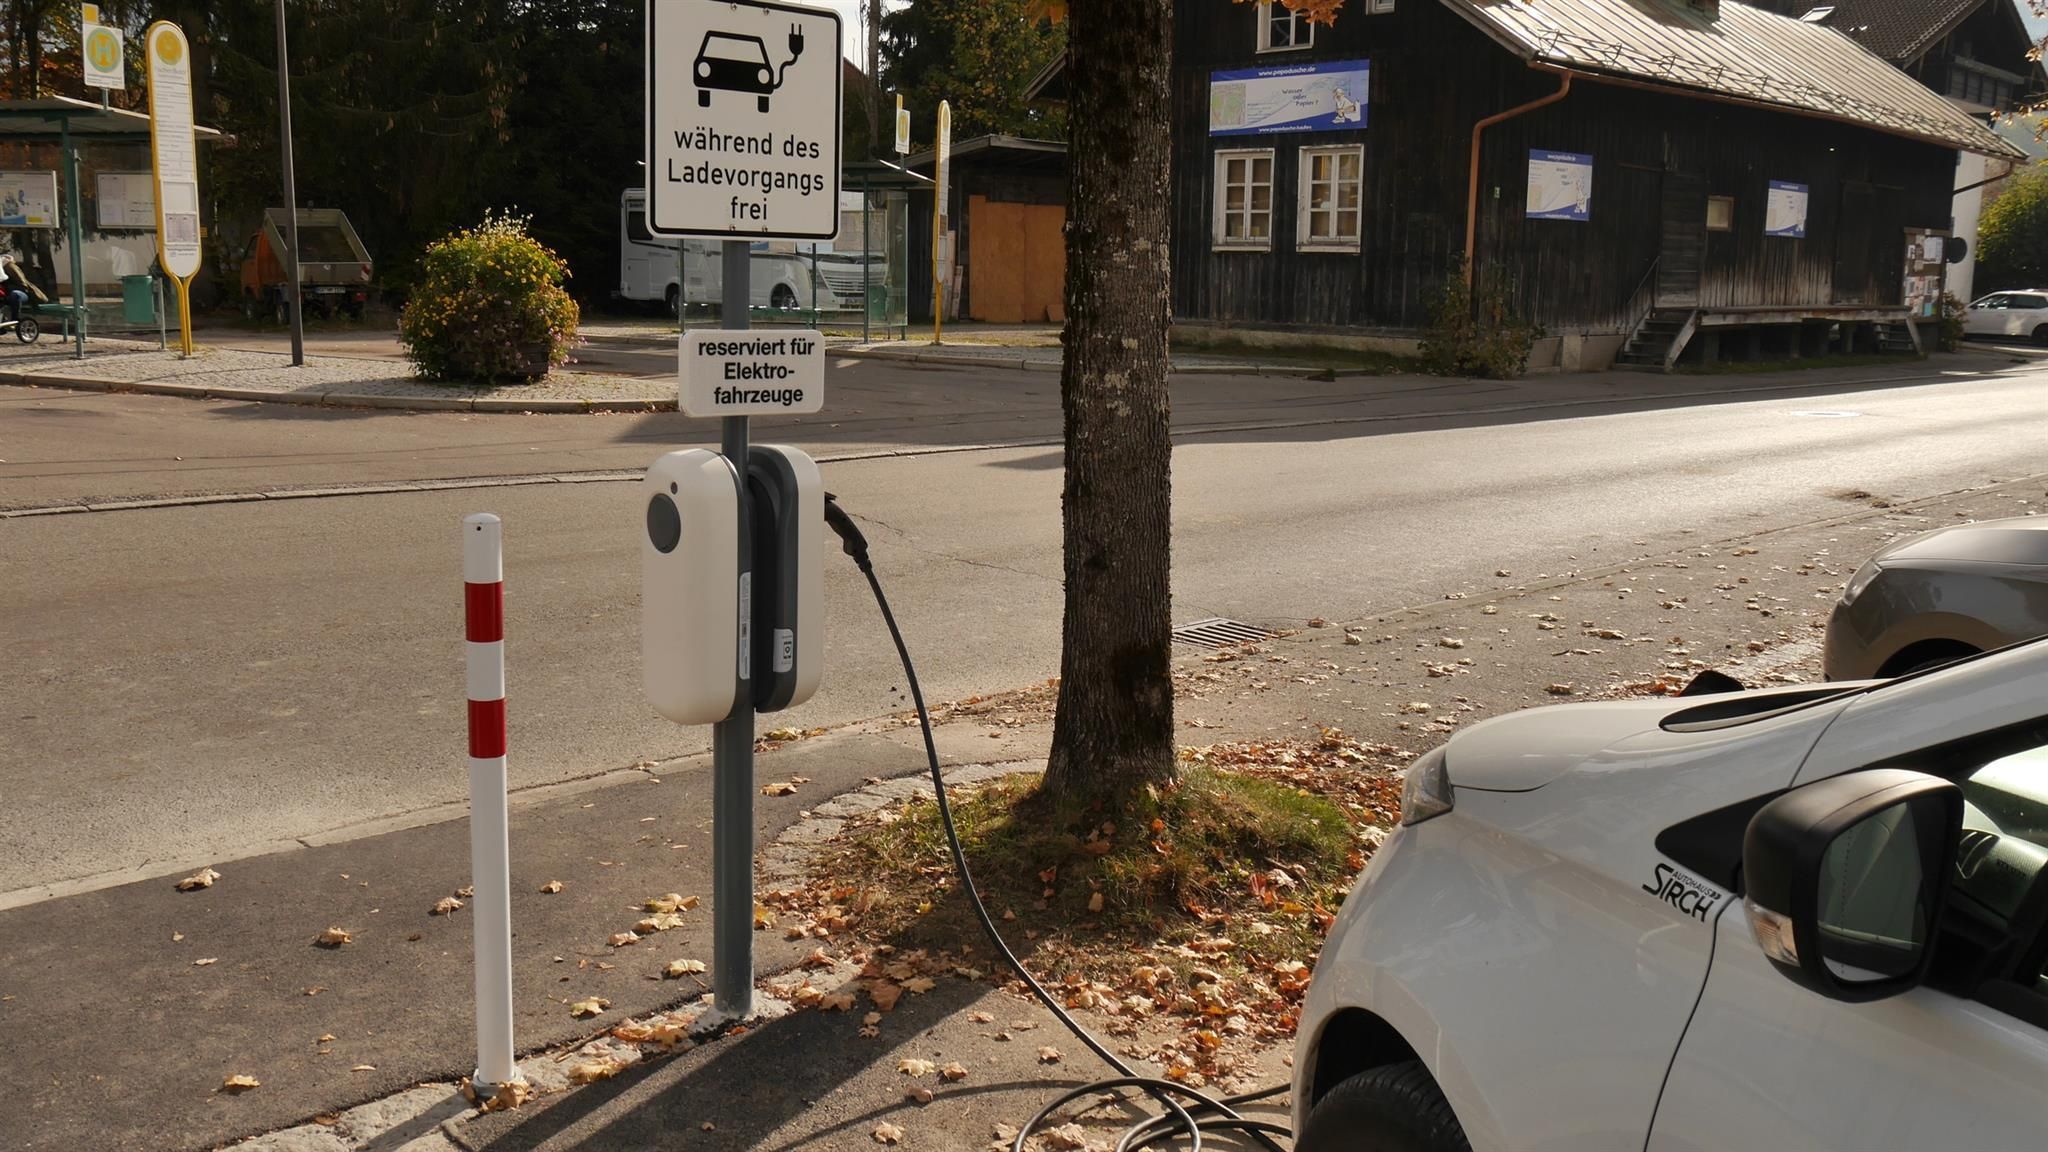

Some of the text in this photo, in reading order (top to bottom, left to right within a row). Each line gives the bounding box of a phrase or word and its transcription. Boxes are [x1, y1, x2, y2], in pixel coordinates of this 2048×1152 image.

[96, 38, 112, 63] H
[674, 126, 820, 159] während des
[668, 158, 824, 196] Ladevorgangs
[730, 196, 768, 220] frei
[698, 338, 815, 356] reserviert für
[724, 362, 795, 380] Elektro-
[714, 386, 803, 406] fahrzeuge
[1641, 863, 1714, 923] SIRCH
[1672, 871, 1712, 897] AUTOHAUS
